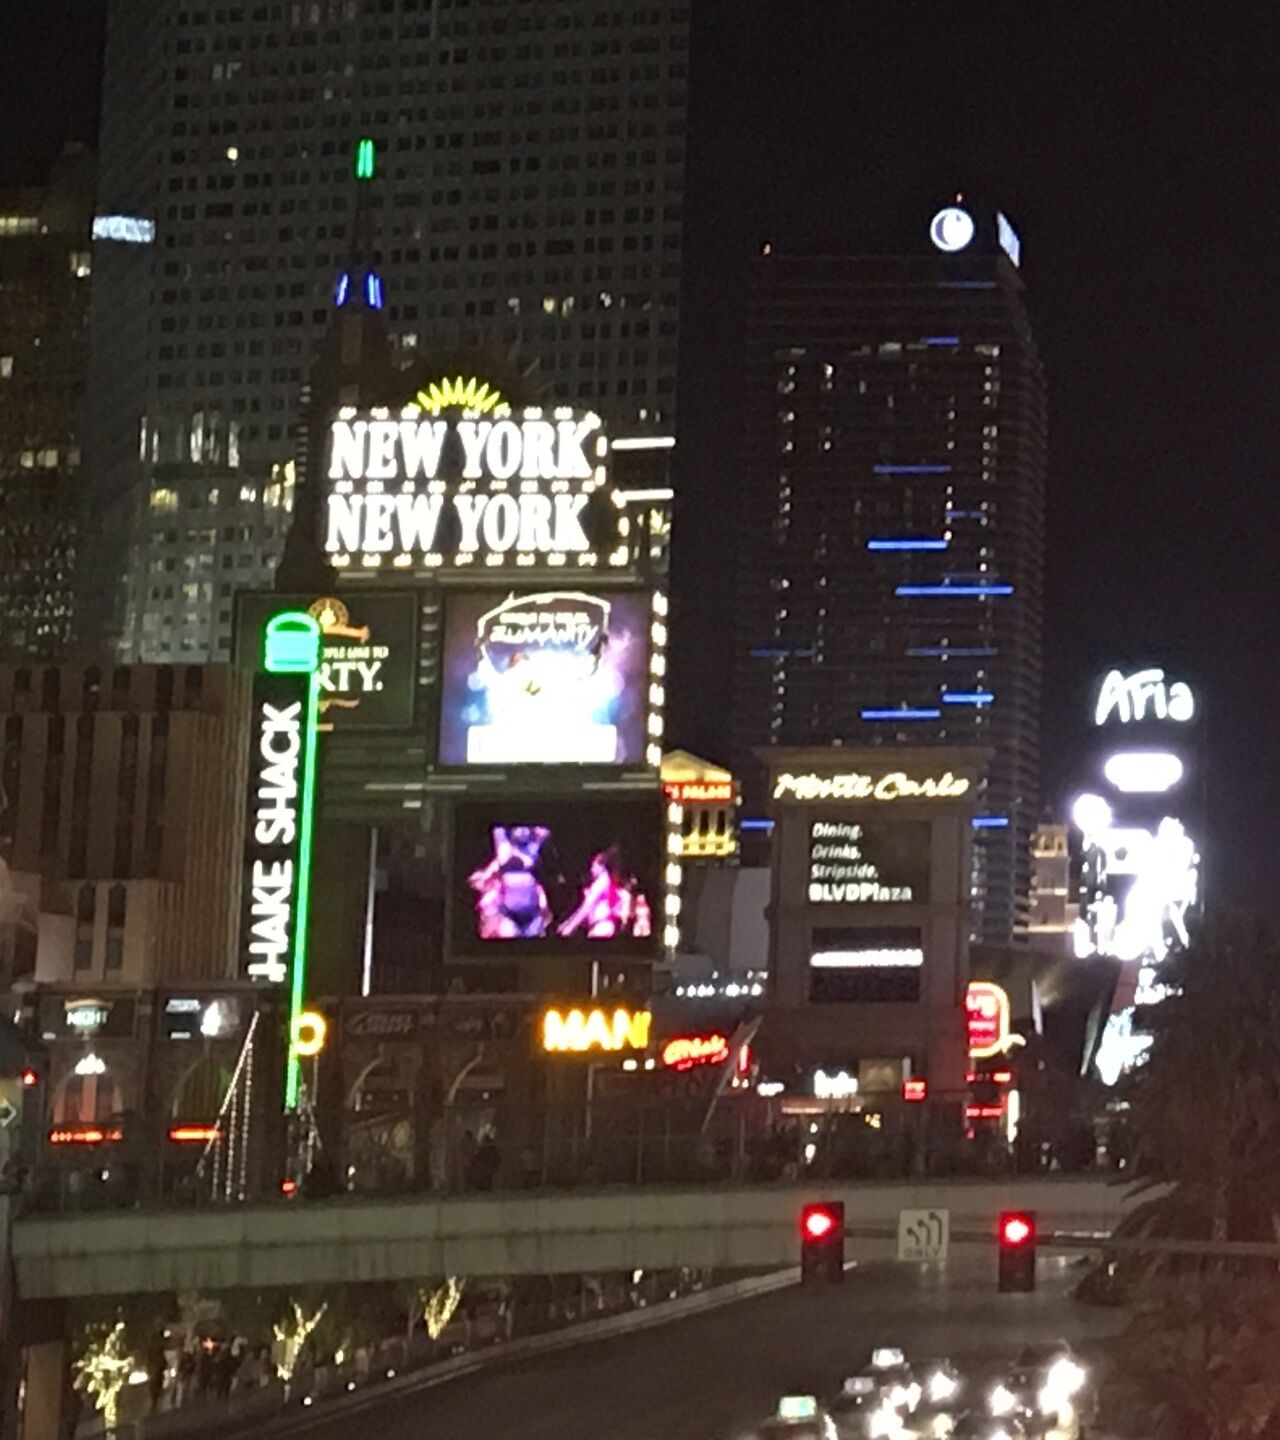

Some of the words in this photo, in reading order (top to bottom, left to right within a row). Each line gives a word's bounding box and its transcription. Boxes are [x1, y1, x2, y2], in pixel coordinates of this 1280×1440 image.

[328, 420, 448, 479] NEW
[459, 420, 596, 479] YORK
[325, 494, 445, 553] NEW
[454, 494, 590, 553] YORK
[1096, 668, 1195, 725] Aria
[255, 701, 302, 846] SHACK
[248, 859, 294, 983] HAKE
